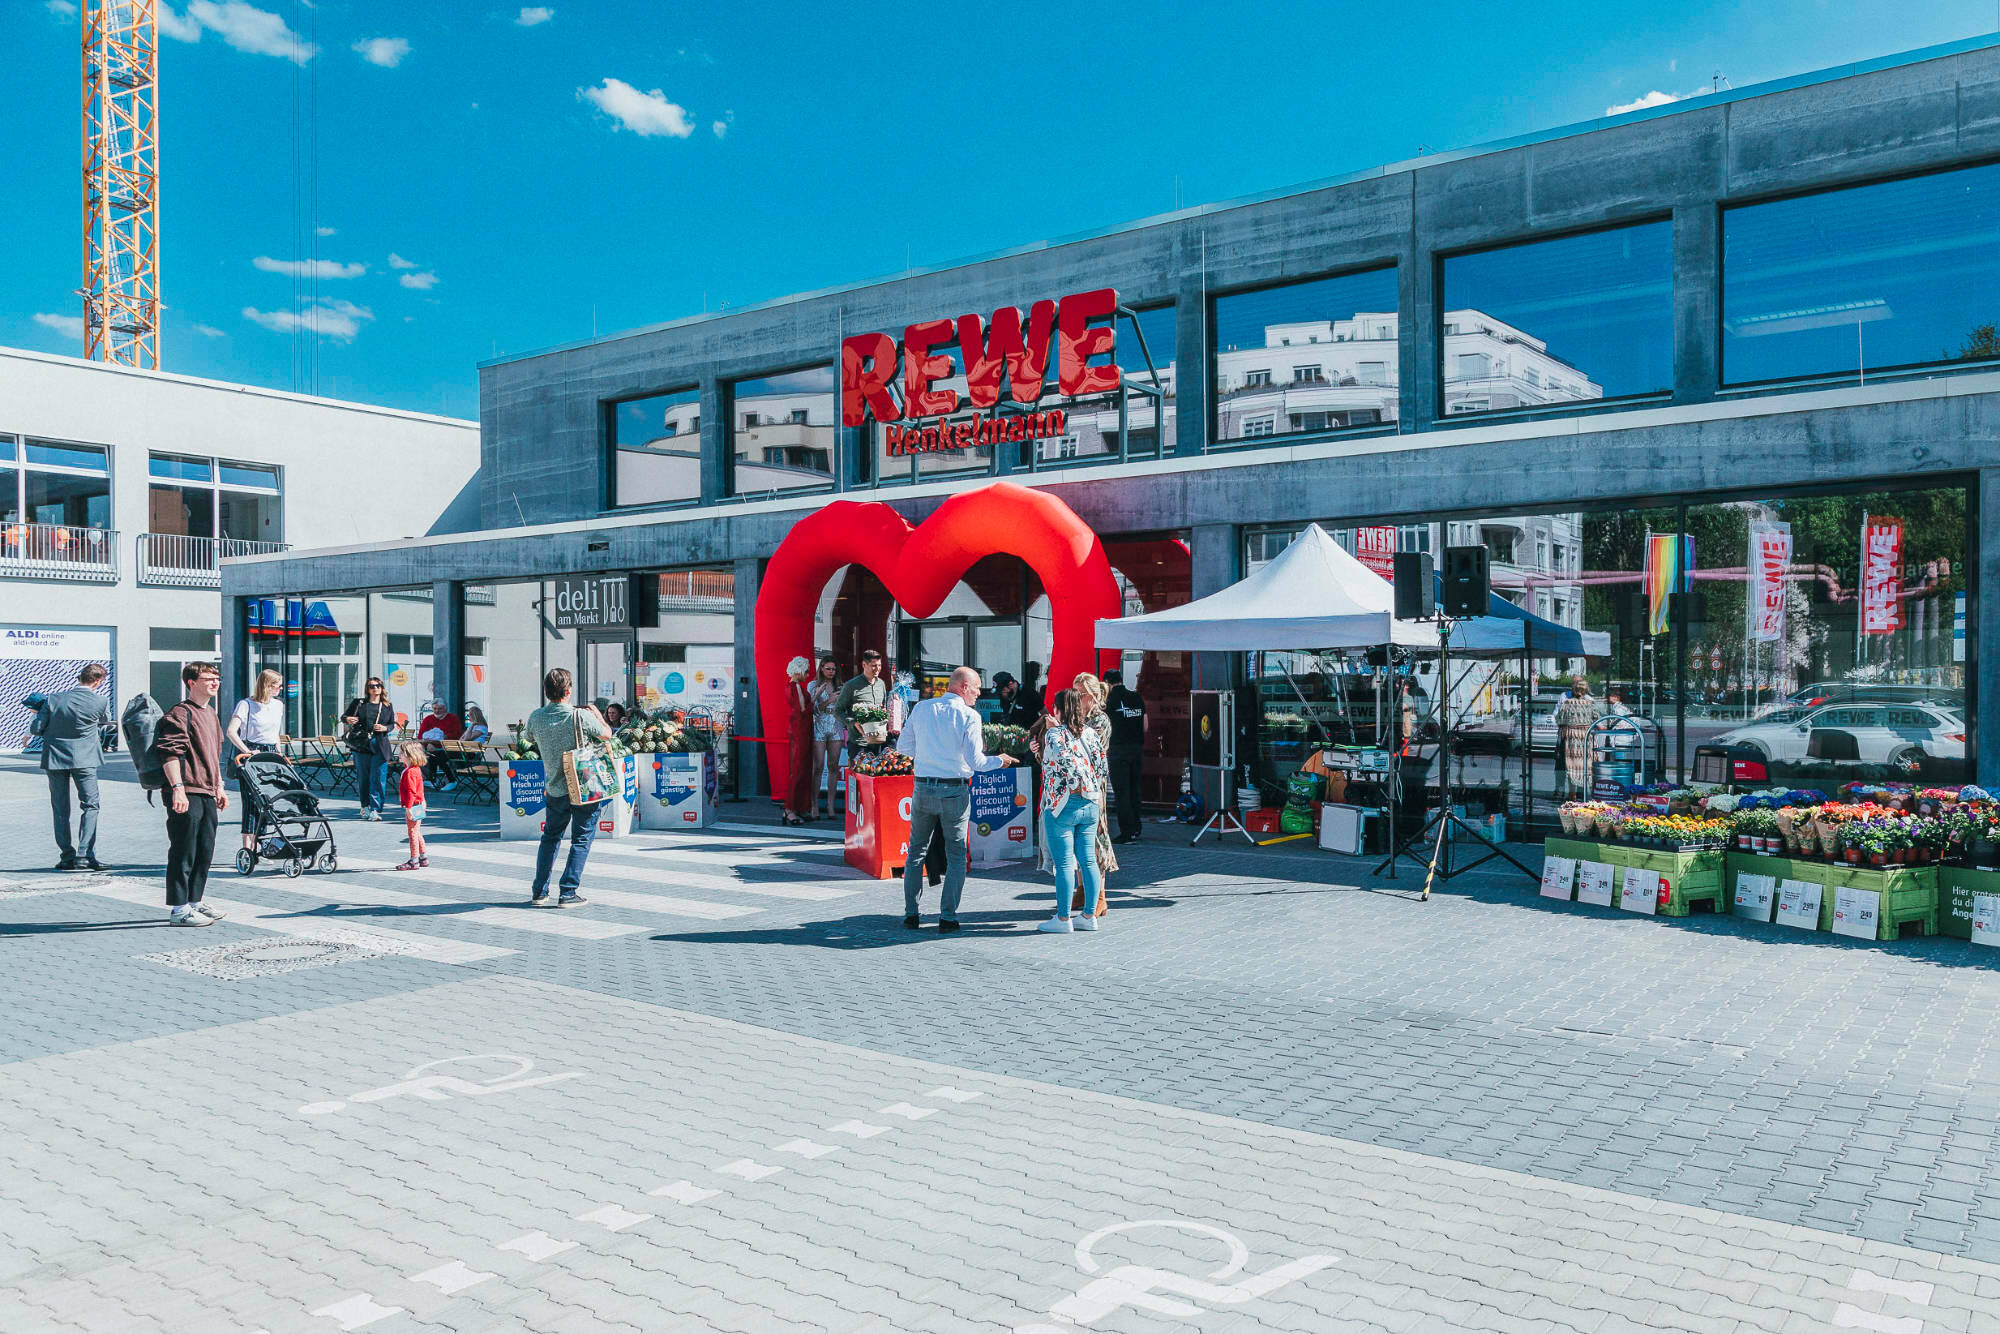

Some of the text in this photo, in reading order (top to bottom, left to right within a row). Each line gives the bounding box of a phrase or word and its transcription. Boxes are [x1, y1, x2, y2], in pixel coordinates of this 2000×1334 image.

[842, 288, 1121, 427] REWE
[885, 410, 1067, 457] Henkelmann
[1865, 524, 1899, 631] REWE
[557, 580, 599, 612] deli
[557, 612, 599, 625] am Markt
[6, 630, 39, 638] ALDI
[1827, 710, 1875, 724] REWE
[517, 772, 540, 781] Täglich
[977, 774, 1007, 786] Täglich
[971, 784, 1014, 796] frisch und
[1609, 784, 1621, 793] App
[516, 795, 543, 804] günstig!
[976, 796, 1011, 805] discount
[976, 805, 1011, 818] günstig!
[1952, 885, 1970, 896] Hier
[1952, 897, 1963, 906] du
